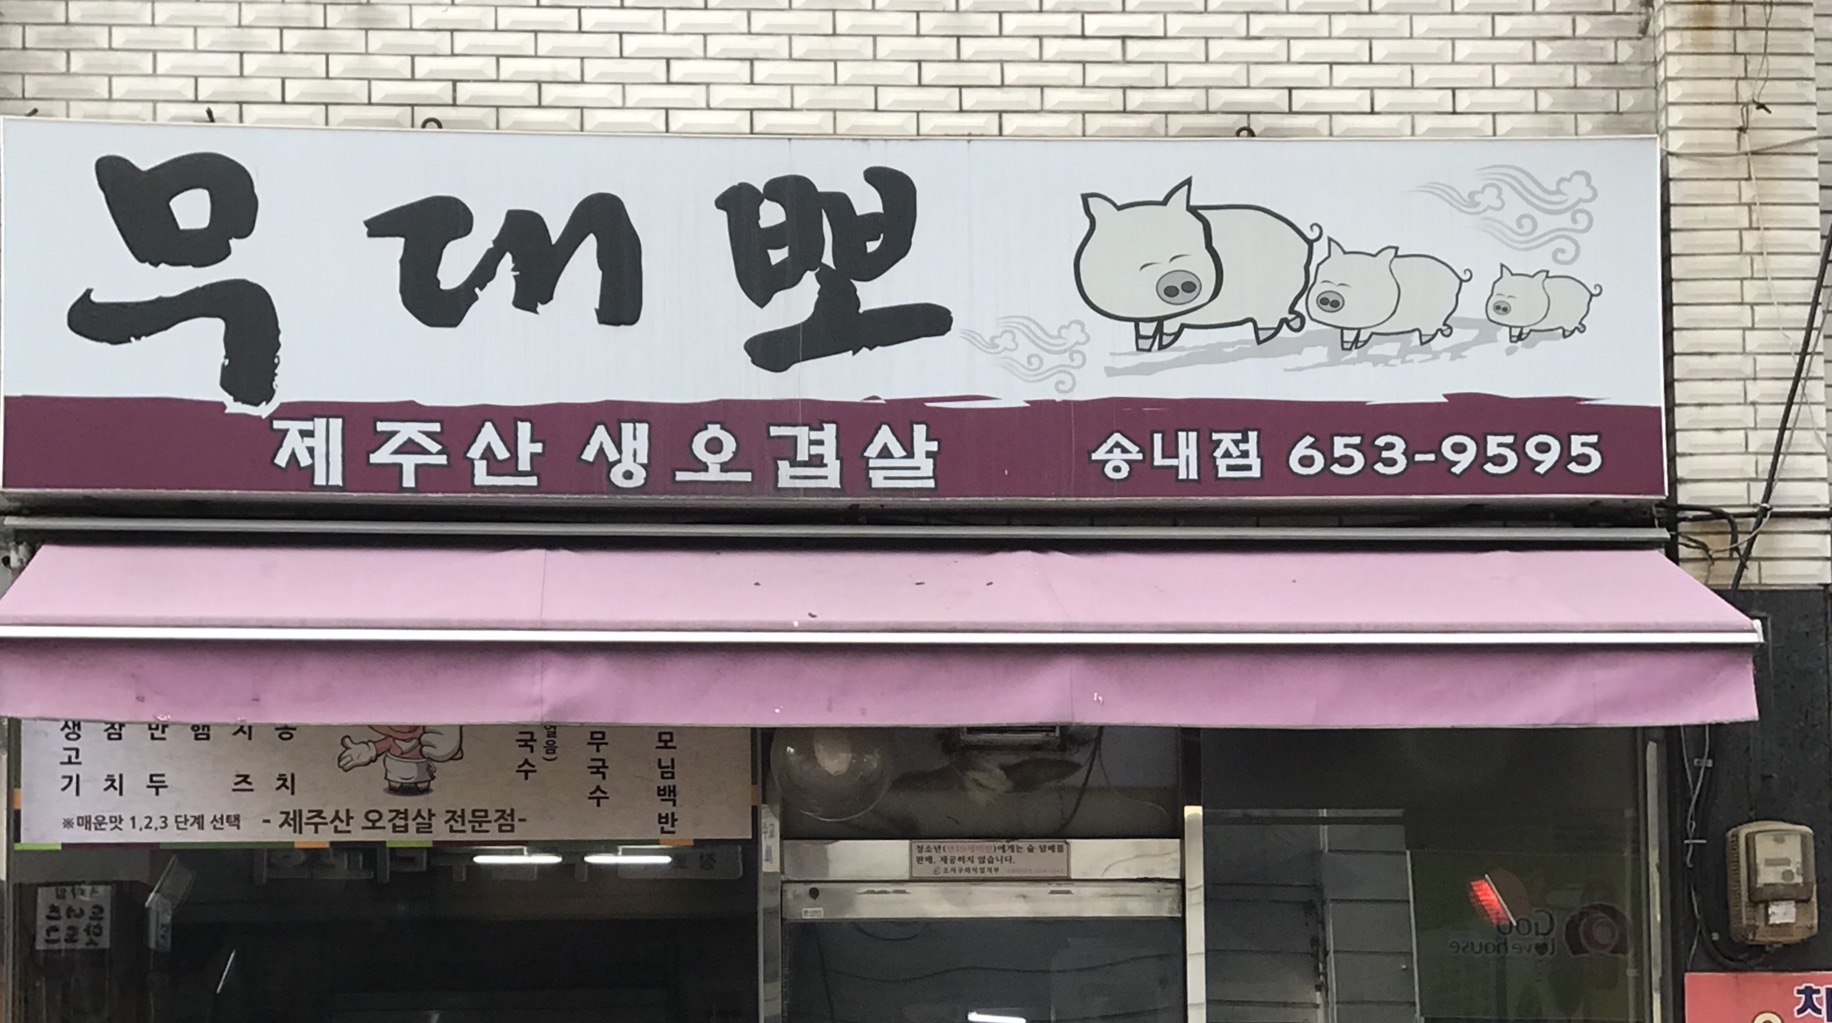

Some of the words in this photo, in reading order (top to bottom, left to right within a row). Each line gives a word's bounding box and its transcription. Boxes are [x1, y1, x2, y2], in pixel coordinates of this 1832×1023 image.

[68, 152, 953, 408] 무대뽀
[273, 415, 543, 488] 제주산
[579, 420, 938, 490] 생오겹살
[1091, 429, 1262, 481] 송내점
[1287, 431, 1604, 479] 653-9595
[130, 815, 169, 832] 1,2,3
[174, 813, 205, 831] 단계
[210, 813, 241, 831] 선택
[361, 807, 436, 834] 오겹살
